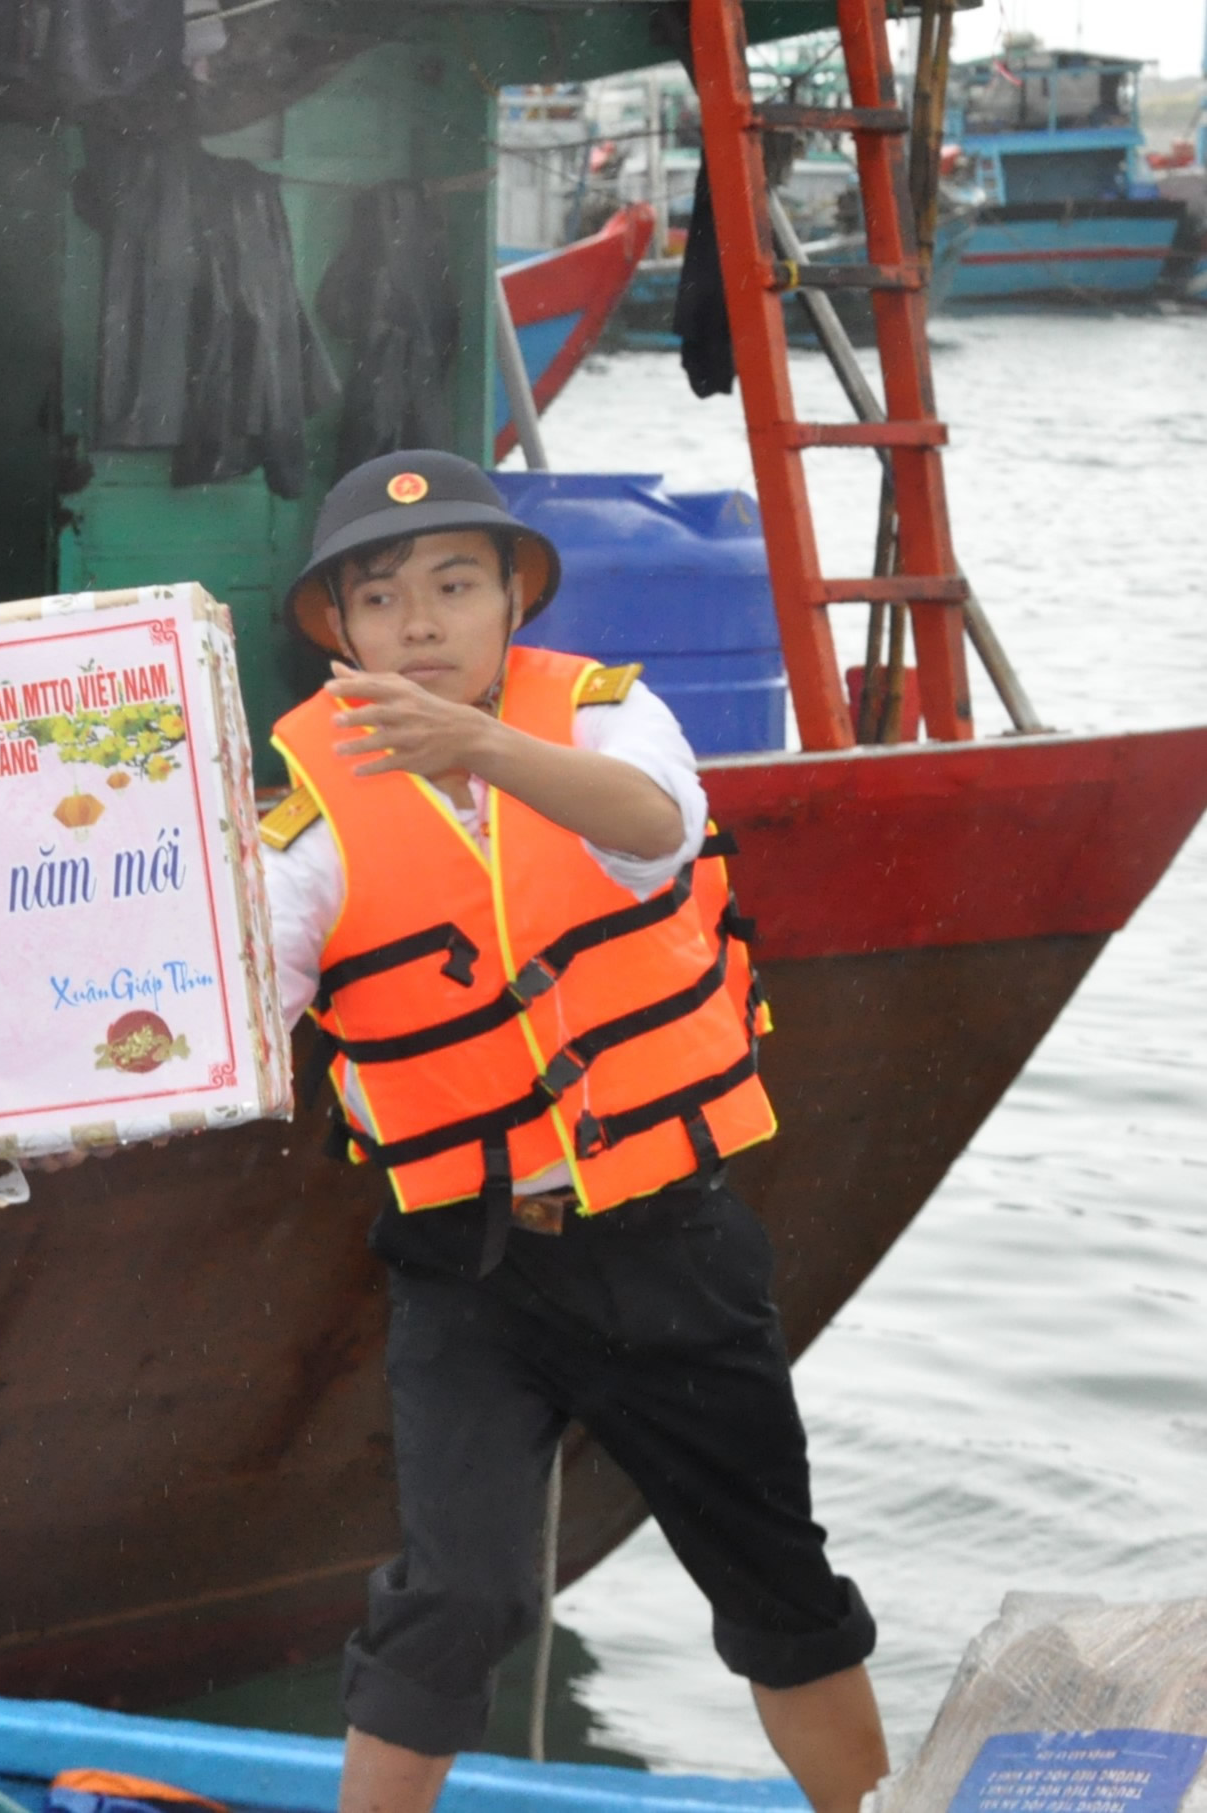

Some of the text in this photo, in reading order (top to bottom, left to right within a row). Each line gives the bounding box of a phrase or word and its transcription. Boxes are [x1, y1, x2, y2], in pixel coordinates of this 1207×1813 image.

[22, 678, 74, 717] MTTQ
[78, 666, 117, 714] VIỆT
[123, 664, 168, 702] NAM
[9, 844, 97, 912] năm
[113, 827, 186, 898] mới
[50, 976, 108, 1010] Xuân
[111, 968, 163, 1011] Giáp
